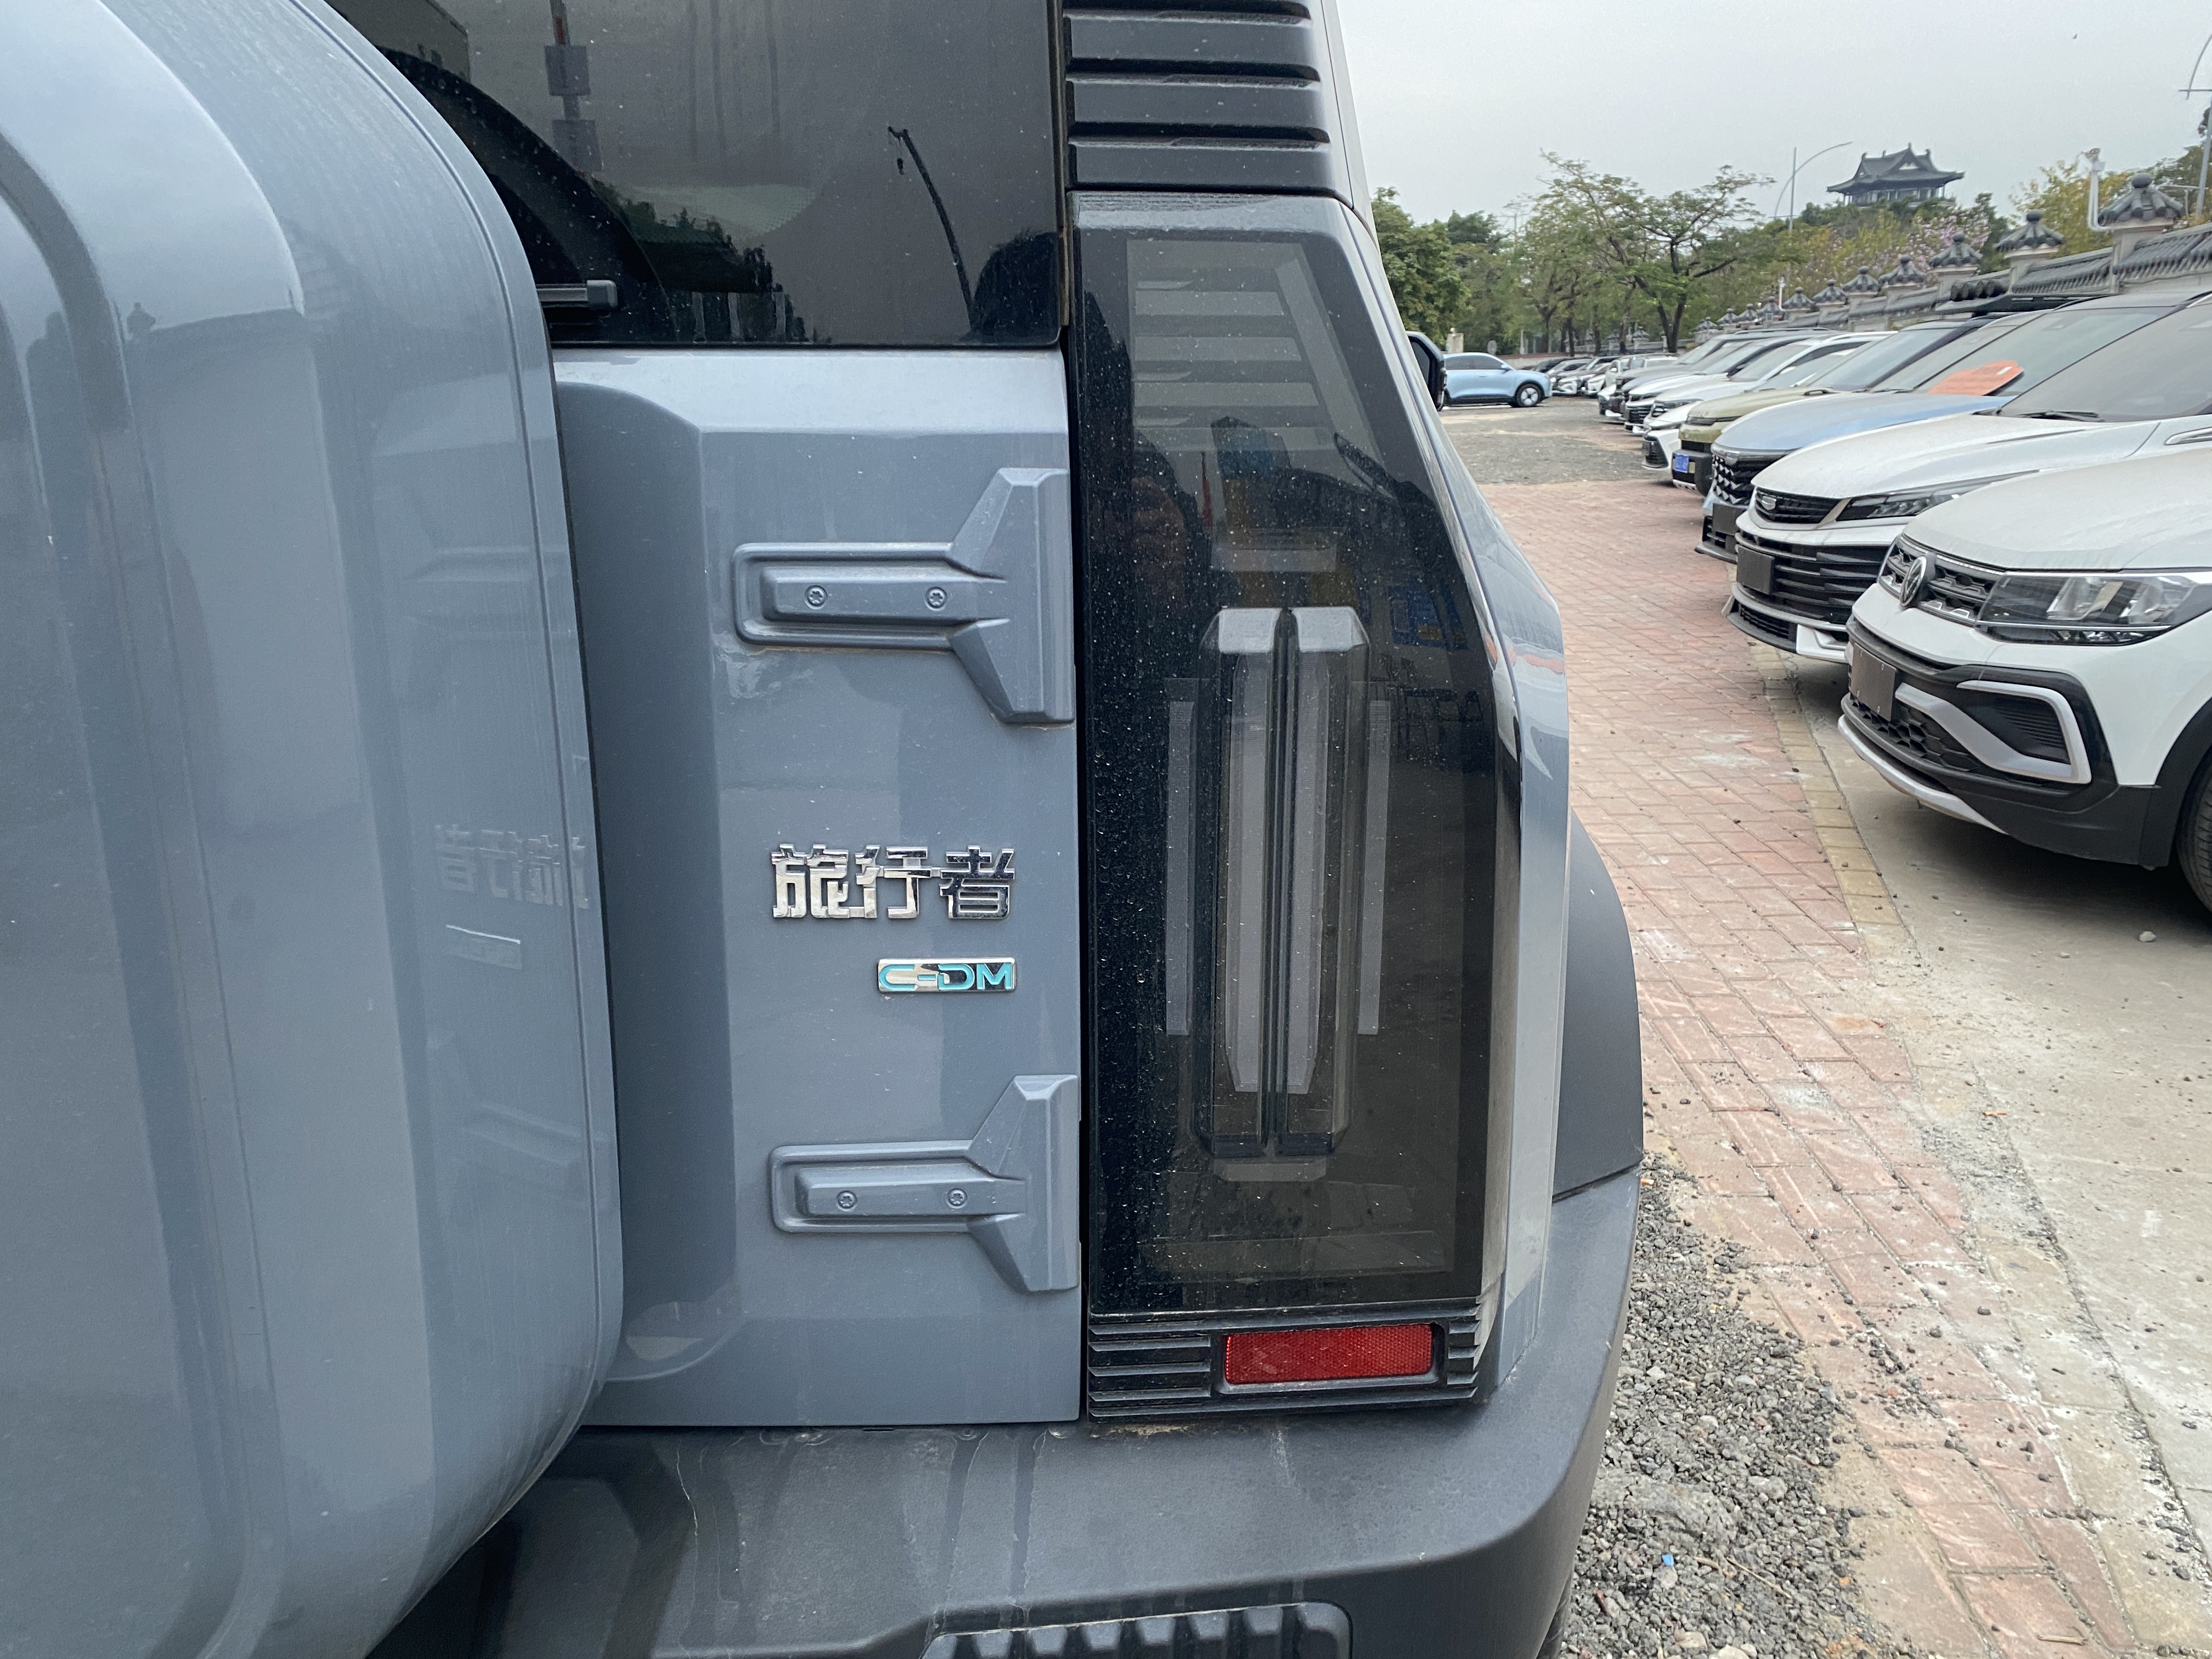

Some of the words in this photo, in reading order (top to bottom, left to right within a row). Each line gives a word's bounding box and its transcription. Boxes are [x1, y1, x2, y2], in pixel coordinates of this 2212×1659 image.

[771, 844, 1015, 918] 旅行者
[879, 963, 1013, 991] C-DM
